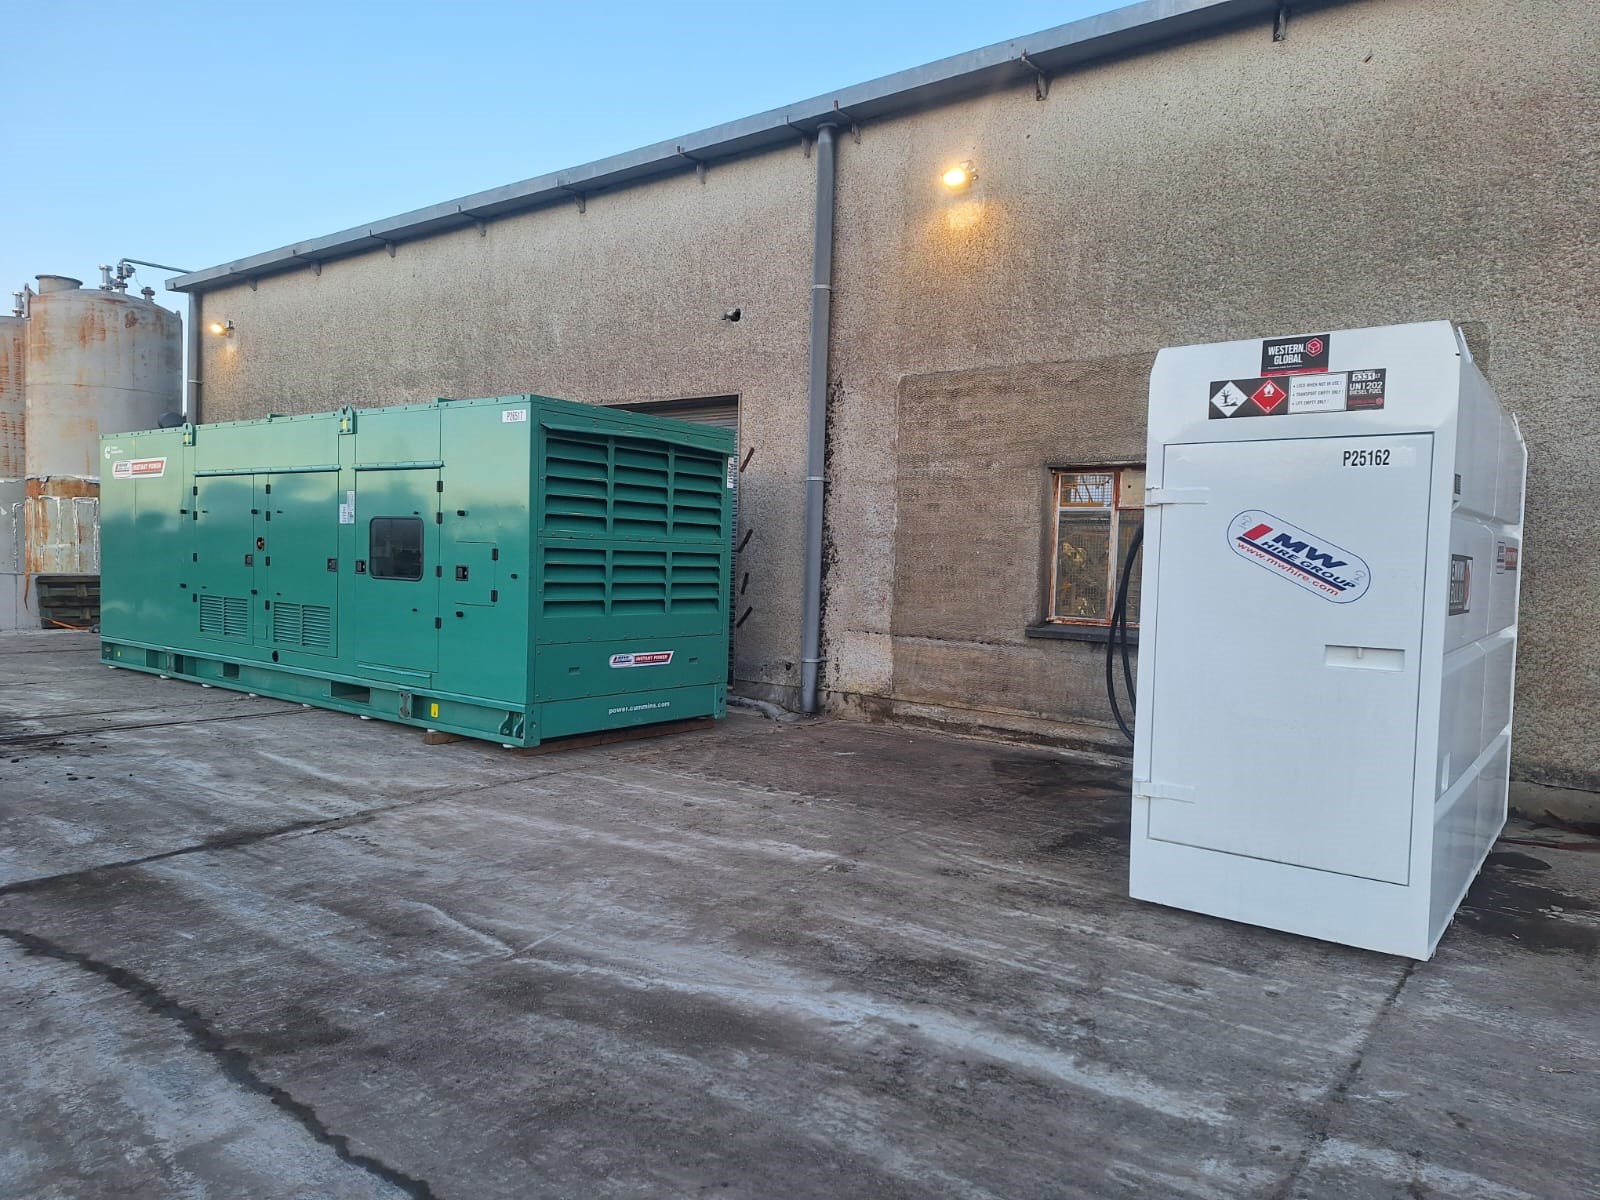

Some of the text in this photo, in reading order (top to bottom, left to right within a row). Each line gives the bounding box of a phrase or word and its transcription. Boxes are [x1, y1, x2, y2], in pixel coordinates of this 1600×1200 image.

[1268, 344, 1304, 355] WESTERN
[1274, 354, 1302, 365] GLOBAL
[1350, 381, 1383, 390] UN1202
[1343, 449, 1390, 466] P25162
[1272, 532, 1349, 569] MW
[1237, 542, 1339, 597] www.mwhire.com
[1261, 541, 1356, 588] HIRE GROUP
[608, 701, 670, 715] power.cummins.com
